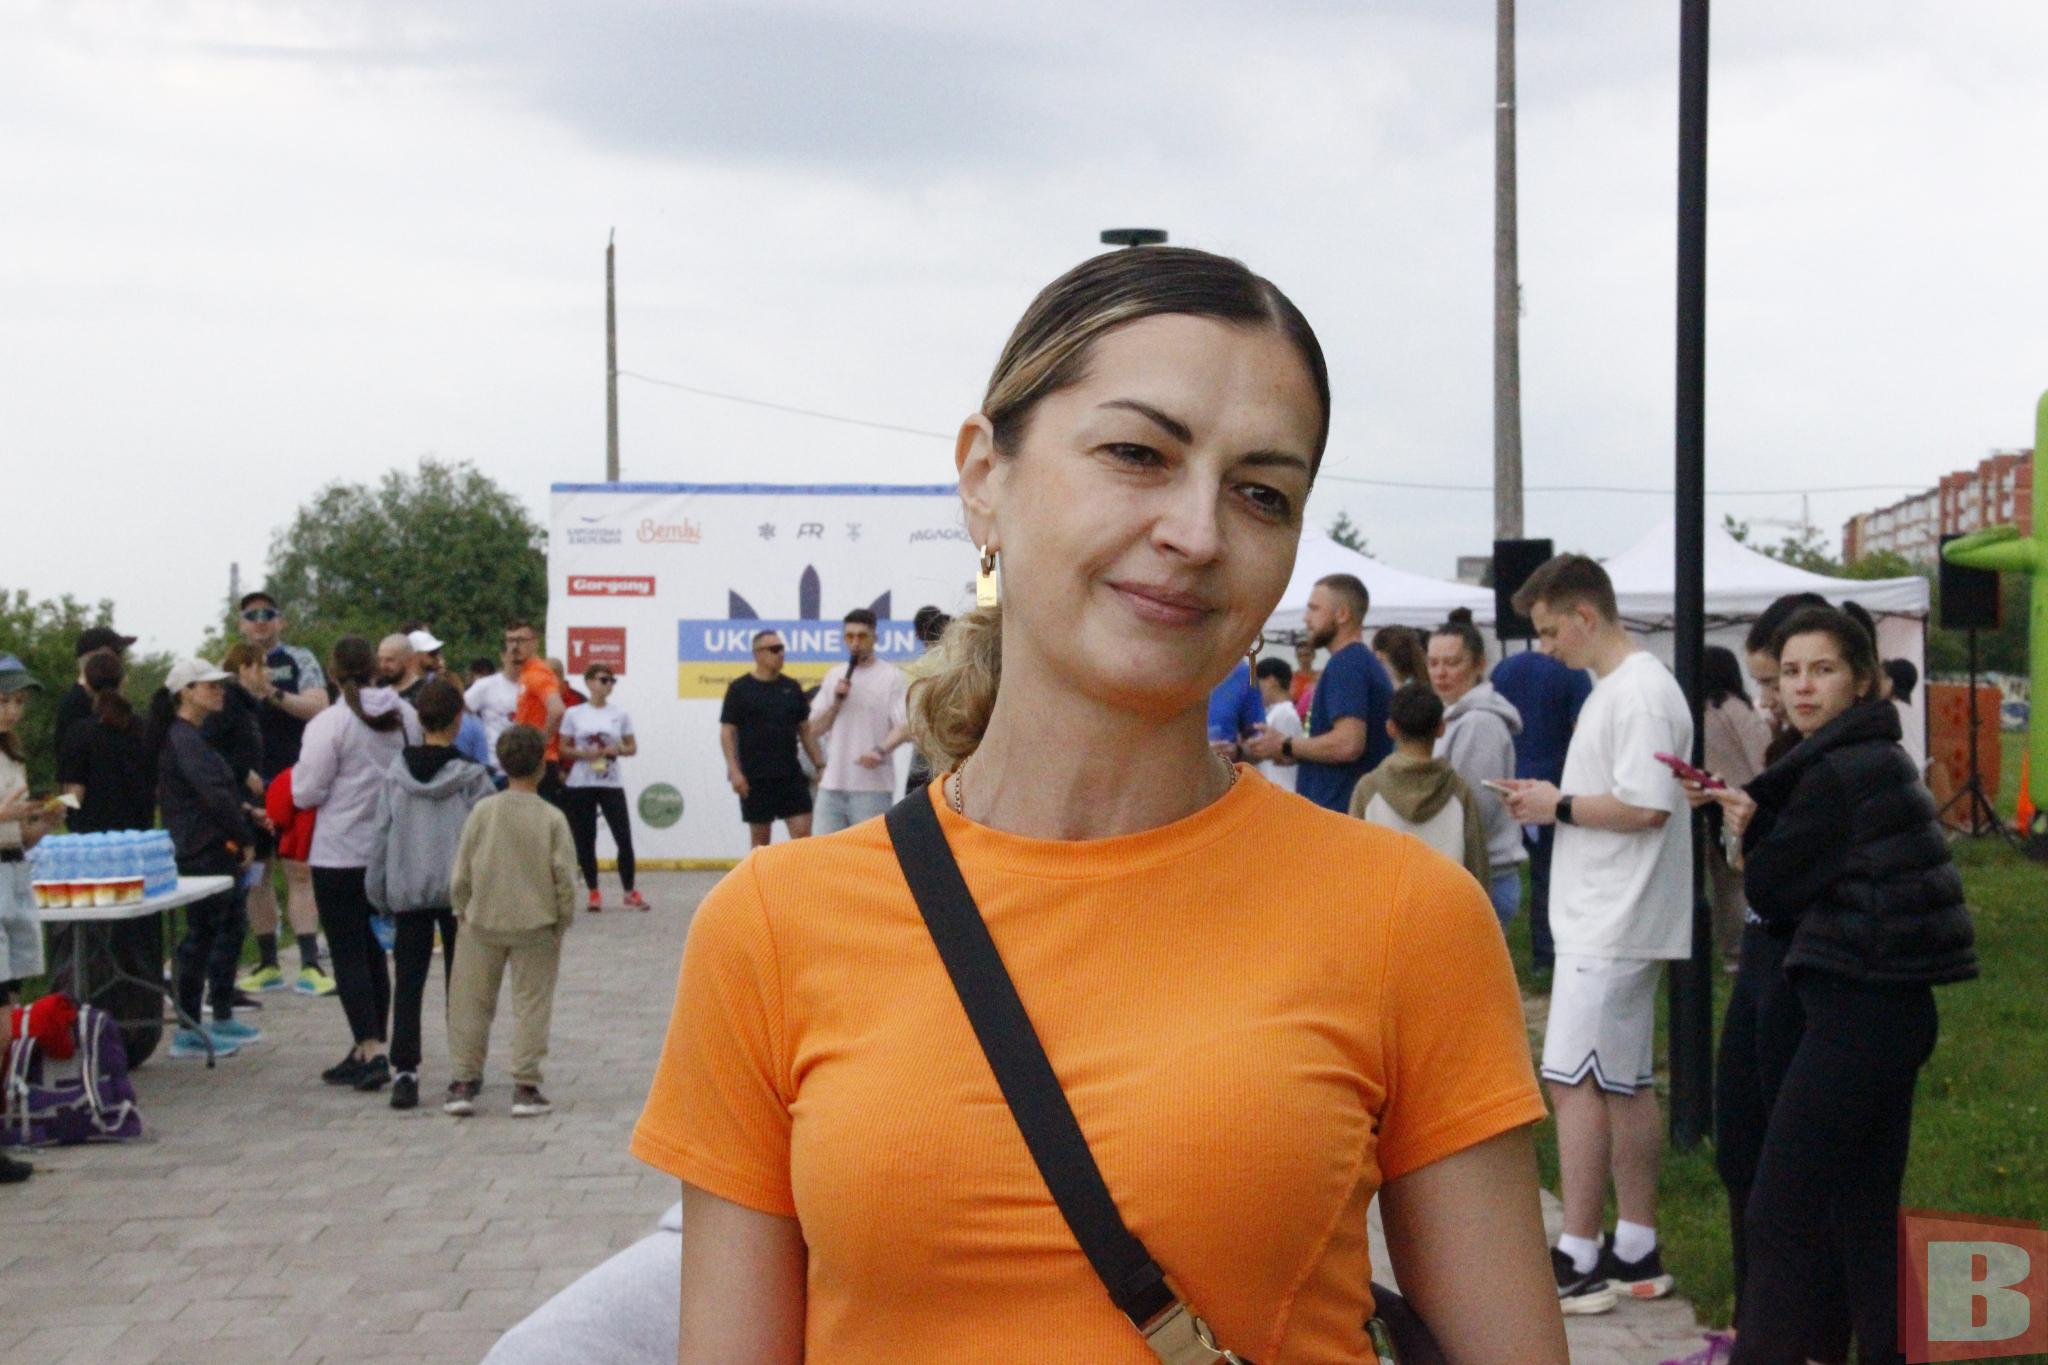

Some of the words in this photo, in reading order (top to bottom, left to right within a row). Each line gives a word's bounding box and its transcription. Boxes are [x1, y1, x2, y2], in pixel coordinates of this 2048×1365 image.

[636, 517, 702, 544] Bembi
[573, 579, 650, 594] Gorgany
[704, 629, 842, 652] UKAINE
[873, 630, 916, 652] UN
